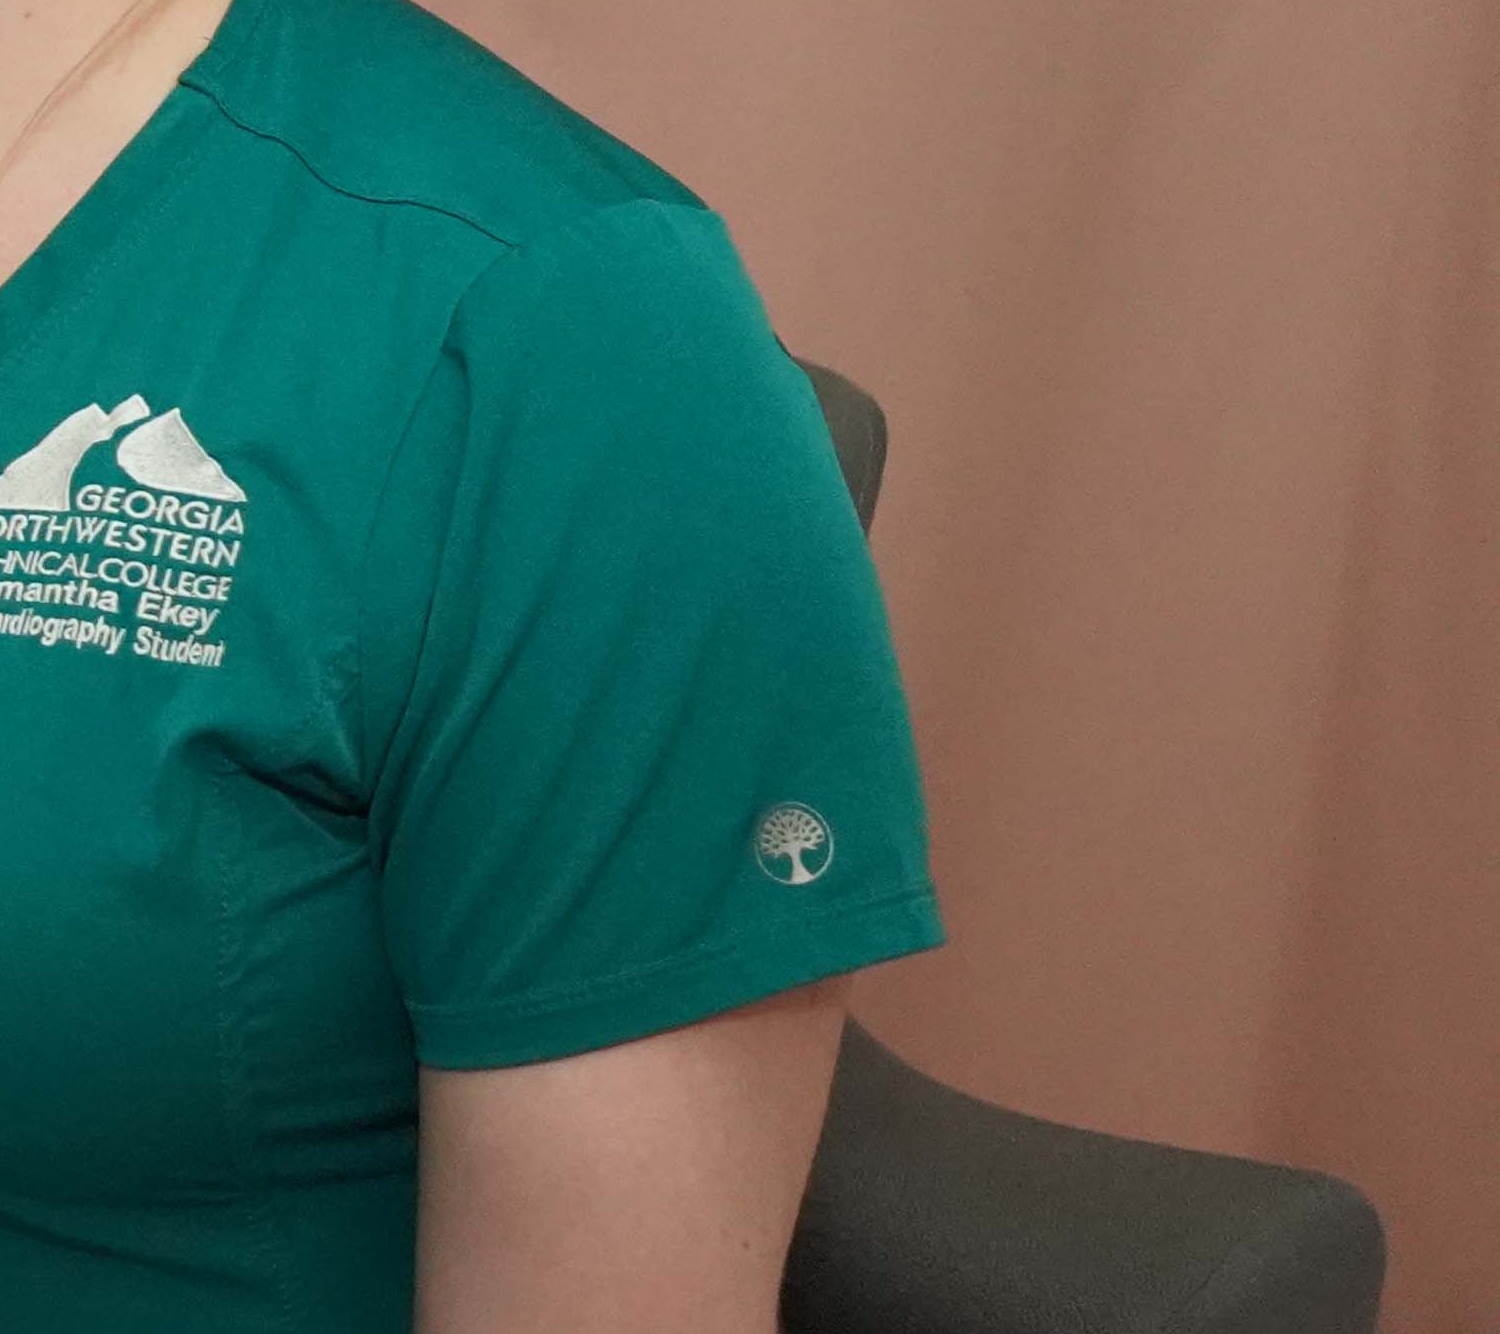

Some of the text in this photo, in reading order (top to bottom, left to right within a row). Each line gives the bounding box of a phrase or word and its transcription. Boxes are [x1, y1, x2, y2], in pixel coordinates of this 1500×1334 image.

[76, 483, 244, 535] GEORGIA
[98, 557, 232, 602] COLLEGE
[136, 593, 219, 632] Ekey
[132, 628, 227, 668] Student
